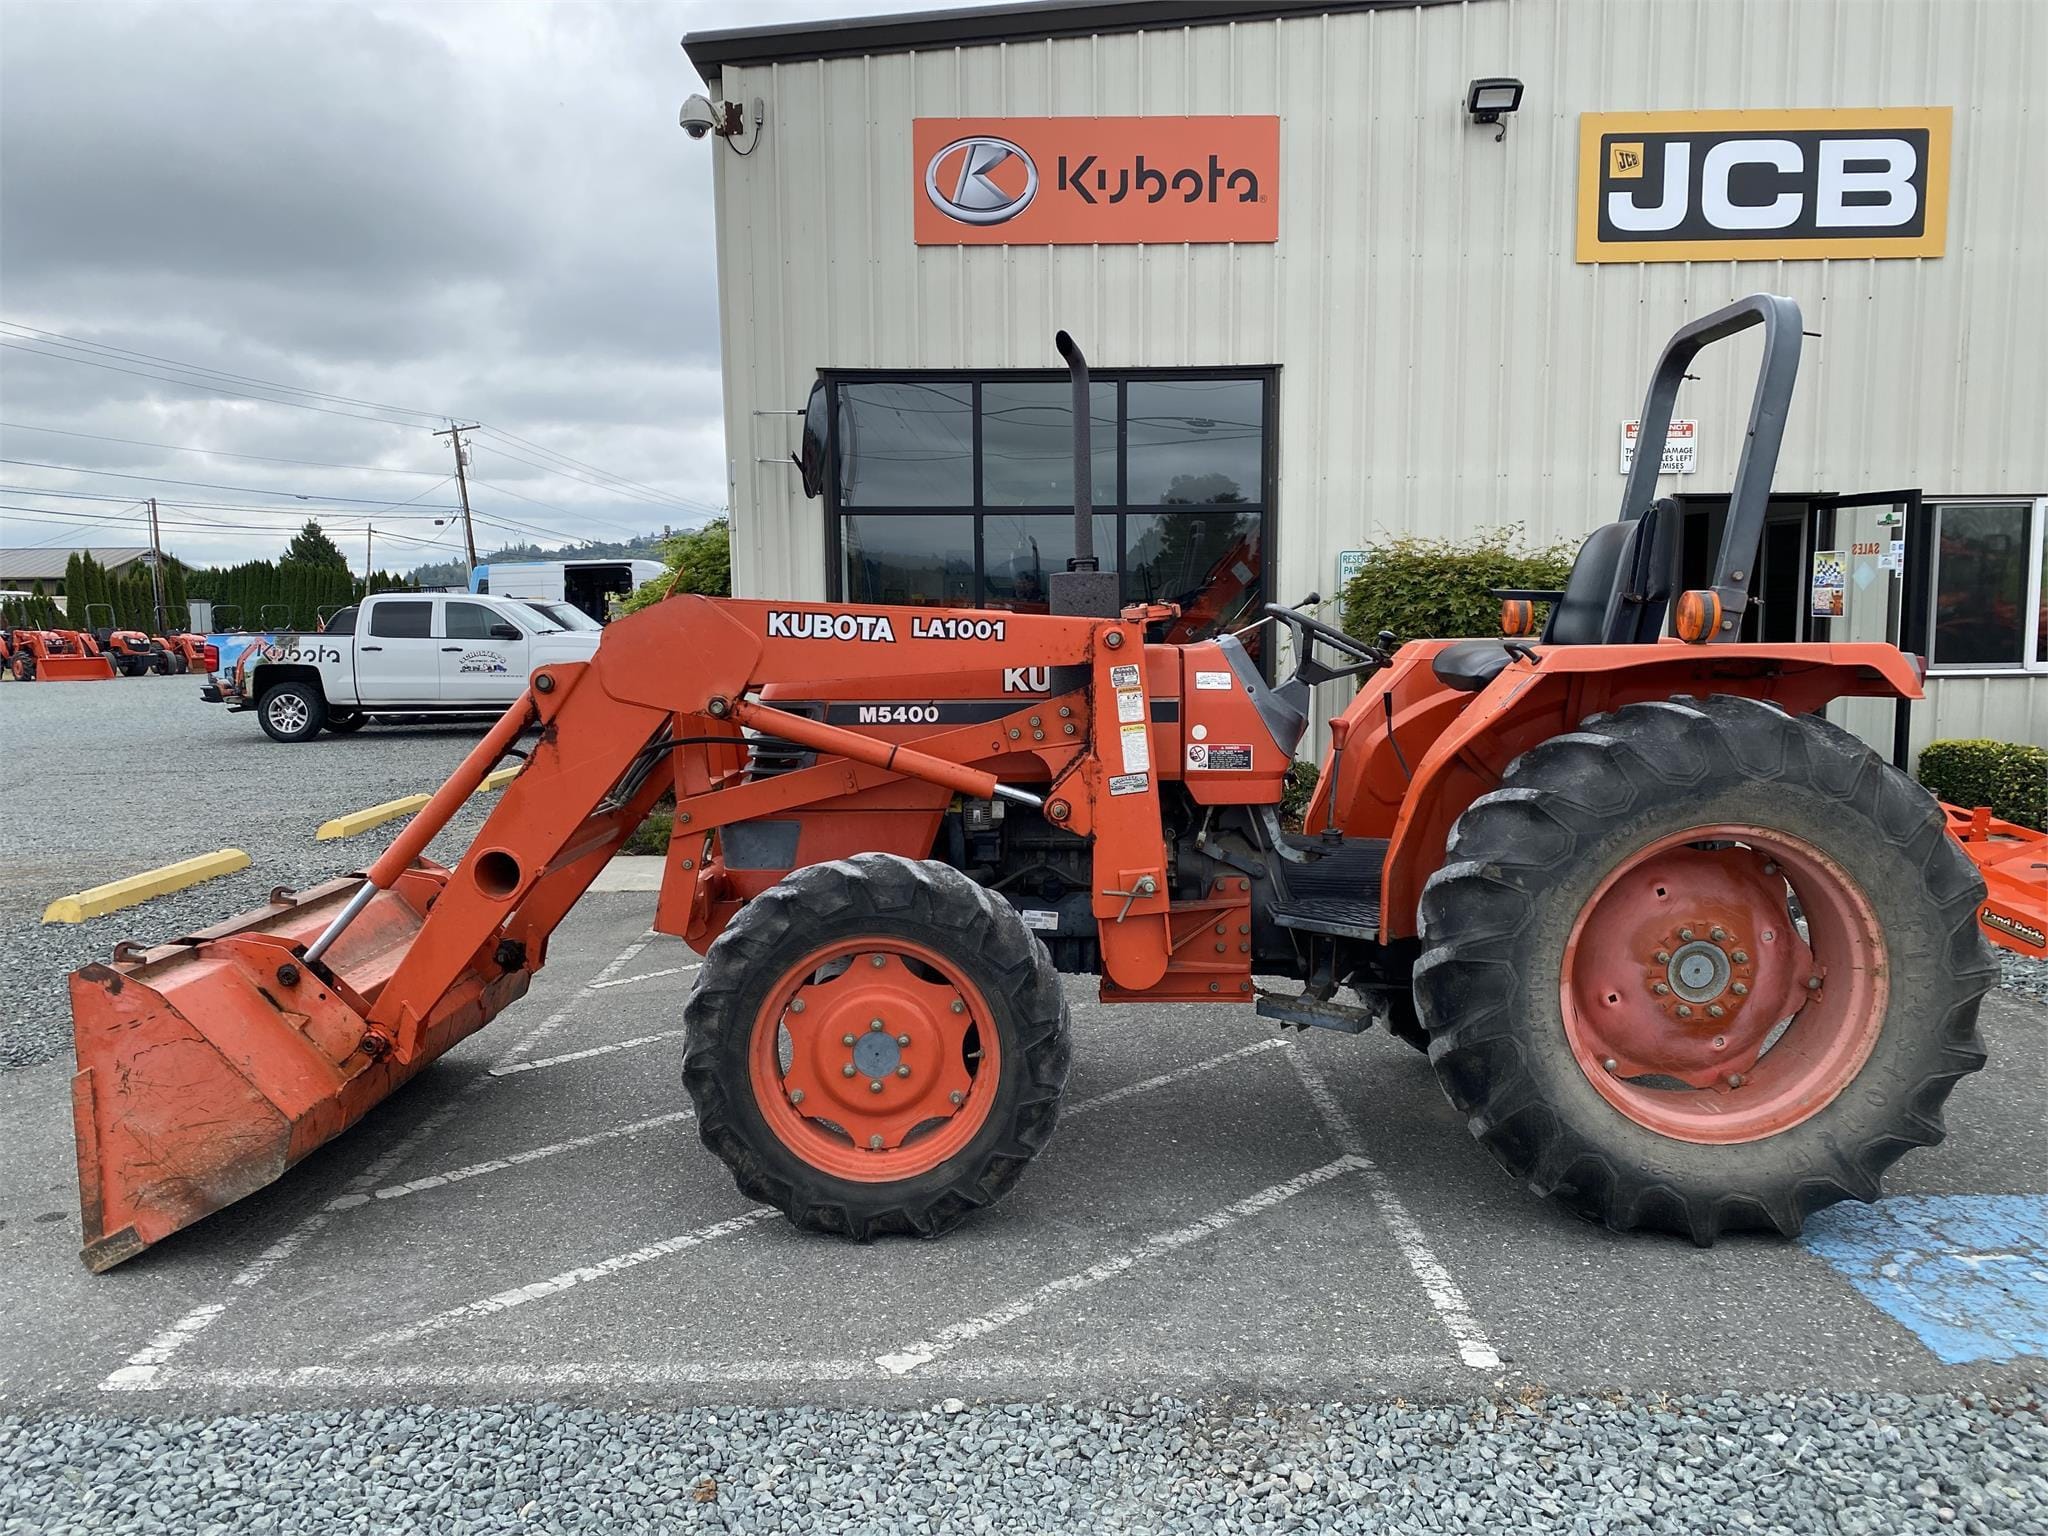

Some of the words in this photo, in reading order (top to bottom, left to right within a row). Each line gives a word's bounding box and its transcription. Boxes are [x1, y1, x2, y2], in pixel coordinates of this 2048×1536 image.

[1617, 150, 1640, 171] JCB
[1058, 154, 1260, 204] Kubota
[1608, 138, 1917, 232] JCB
[767, 611, 896, 642] KUBOTA
[912, 616, 1006, 642] LA1001
[256, 644, 341, 663] Kubota
[859, 705, 939, 723] M5400
[1983, 907, 2012, 927] Land
[2014, 920, 2046, 941] Pride
